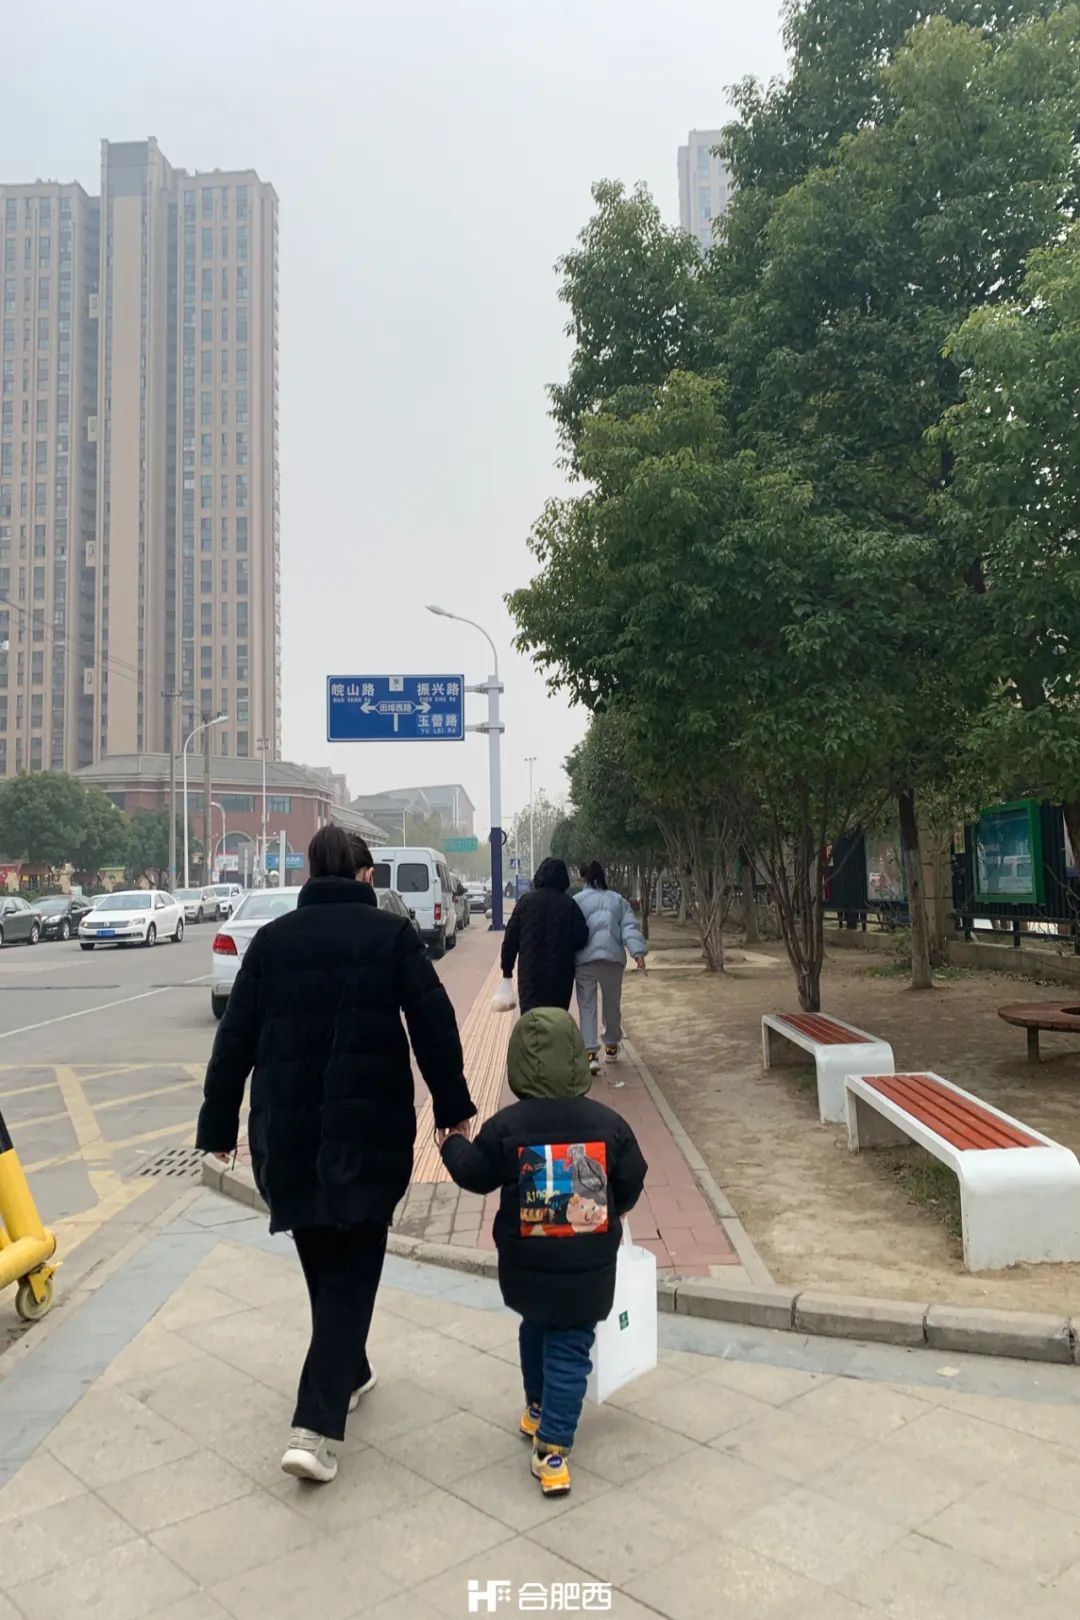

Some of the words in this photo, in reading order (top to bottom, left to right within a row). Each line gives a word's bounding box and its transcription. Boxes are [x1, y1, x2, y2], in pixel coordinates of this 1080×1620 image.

[331, 683, 375, 696] 皖山路
[417, 682, 459, 696] 振兴路
[417, 714, 457, 727] 玉蕾路
